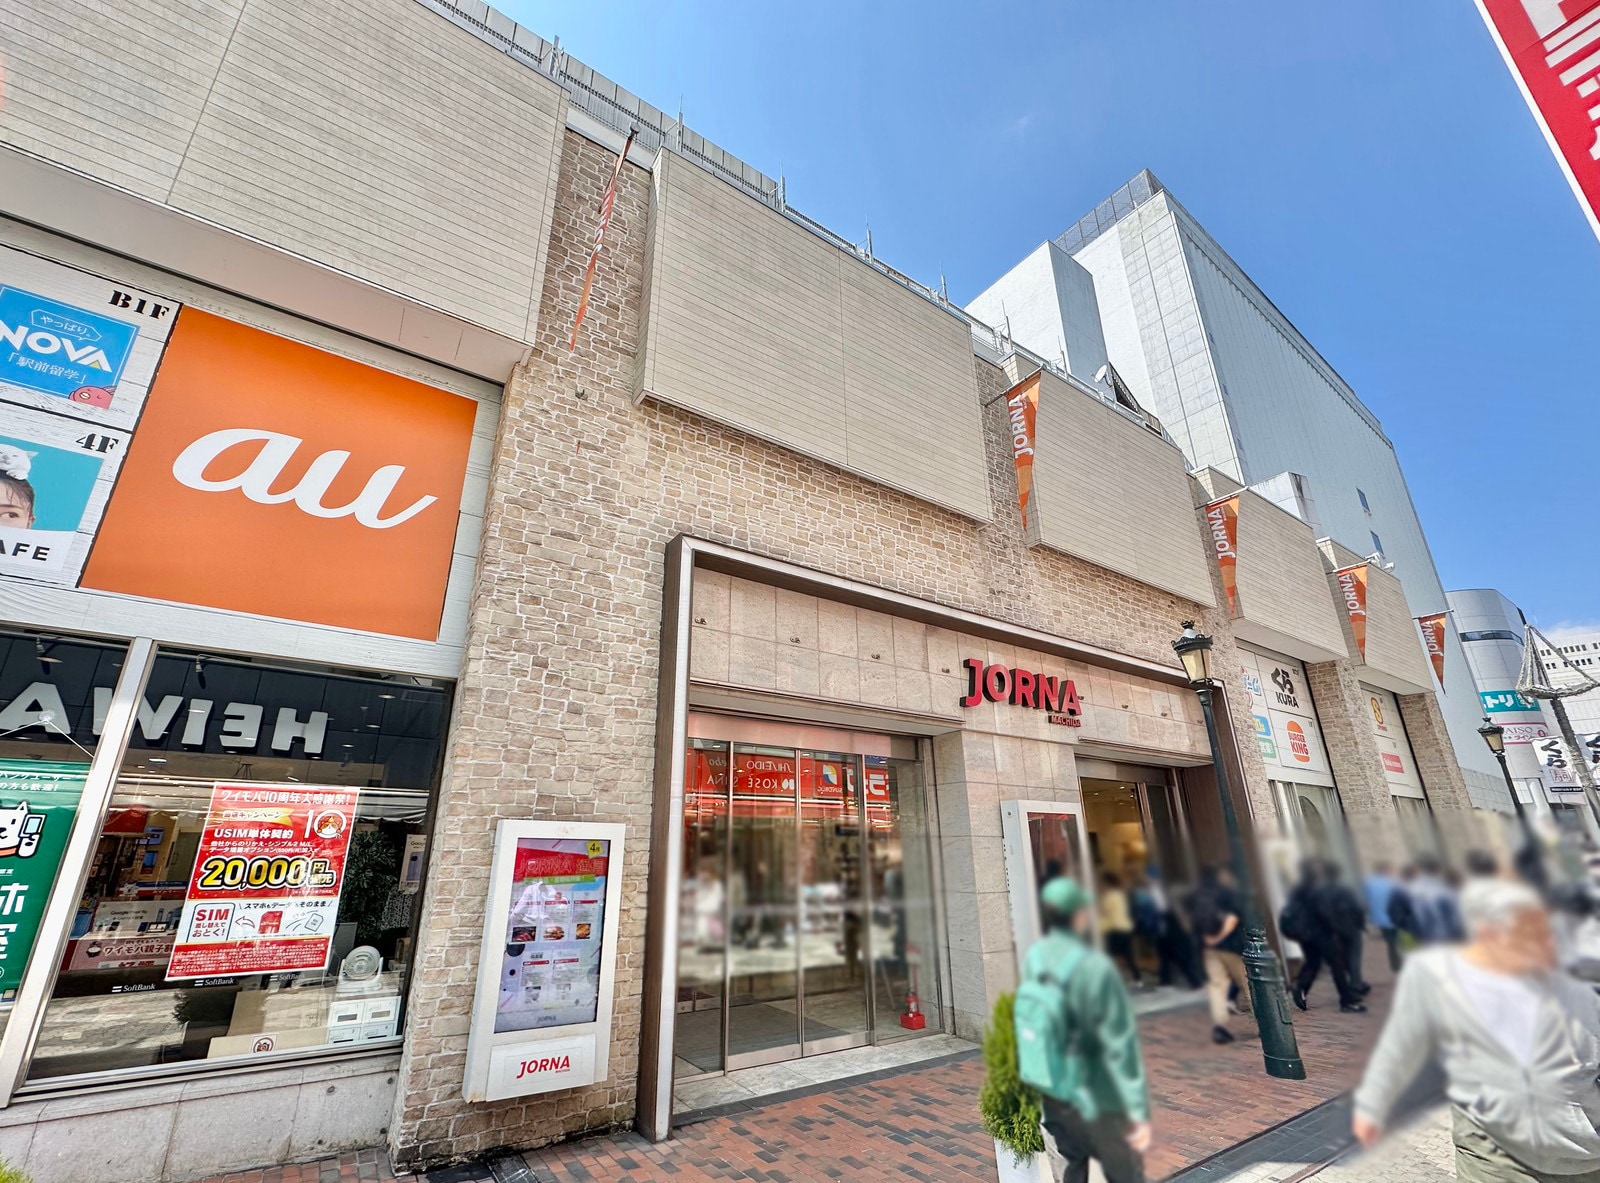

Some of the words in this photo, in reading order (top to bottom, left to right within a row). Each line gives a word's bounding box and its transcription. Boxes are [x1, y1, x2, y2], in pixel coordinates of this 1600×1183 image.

[108, 289, 170, 320] B1F
[0, 321, 113, 373] NOVA
[1008, 392, 1034, 458] JORNA
[75, 432, 119, 453] 4F
[172, 428, 438, 529] au
[1207, 507, 1236, 560] JORNA
[1338, 573, 1366, 616] JORNA
[1420, 620, 1444, 656] JORNA
[960, 658, 1082, 715] JORNA
[1275, 691, 1300, 708] KURA
[1481, 694, 1514, 708] トリ
[1049, 714, 1081, 727] MACHIDA
[1288, 732, 1306, 743] BURGER
[1290, 741, 1309, 755] KING
[200, 857, 308, 888] 20,000
[195, 908, 230, 921] SIM
[123, 983, 156, 992] SoftBank
[204, 977, 234, 986] SoftBank
[516, 1056, 570, 1079] JORNA
